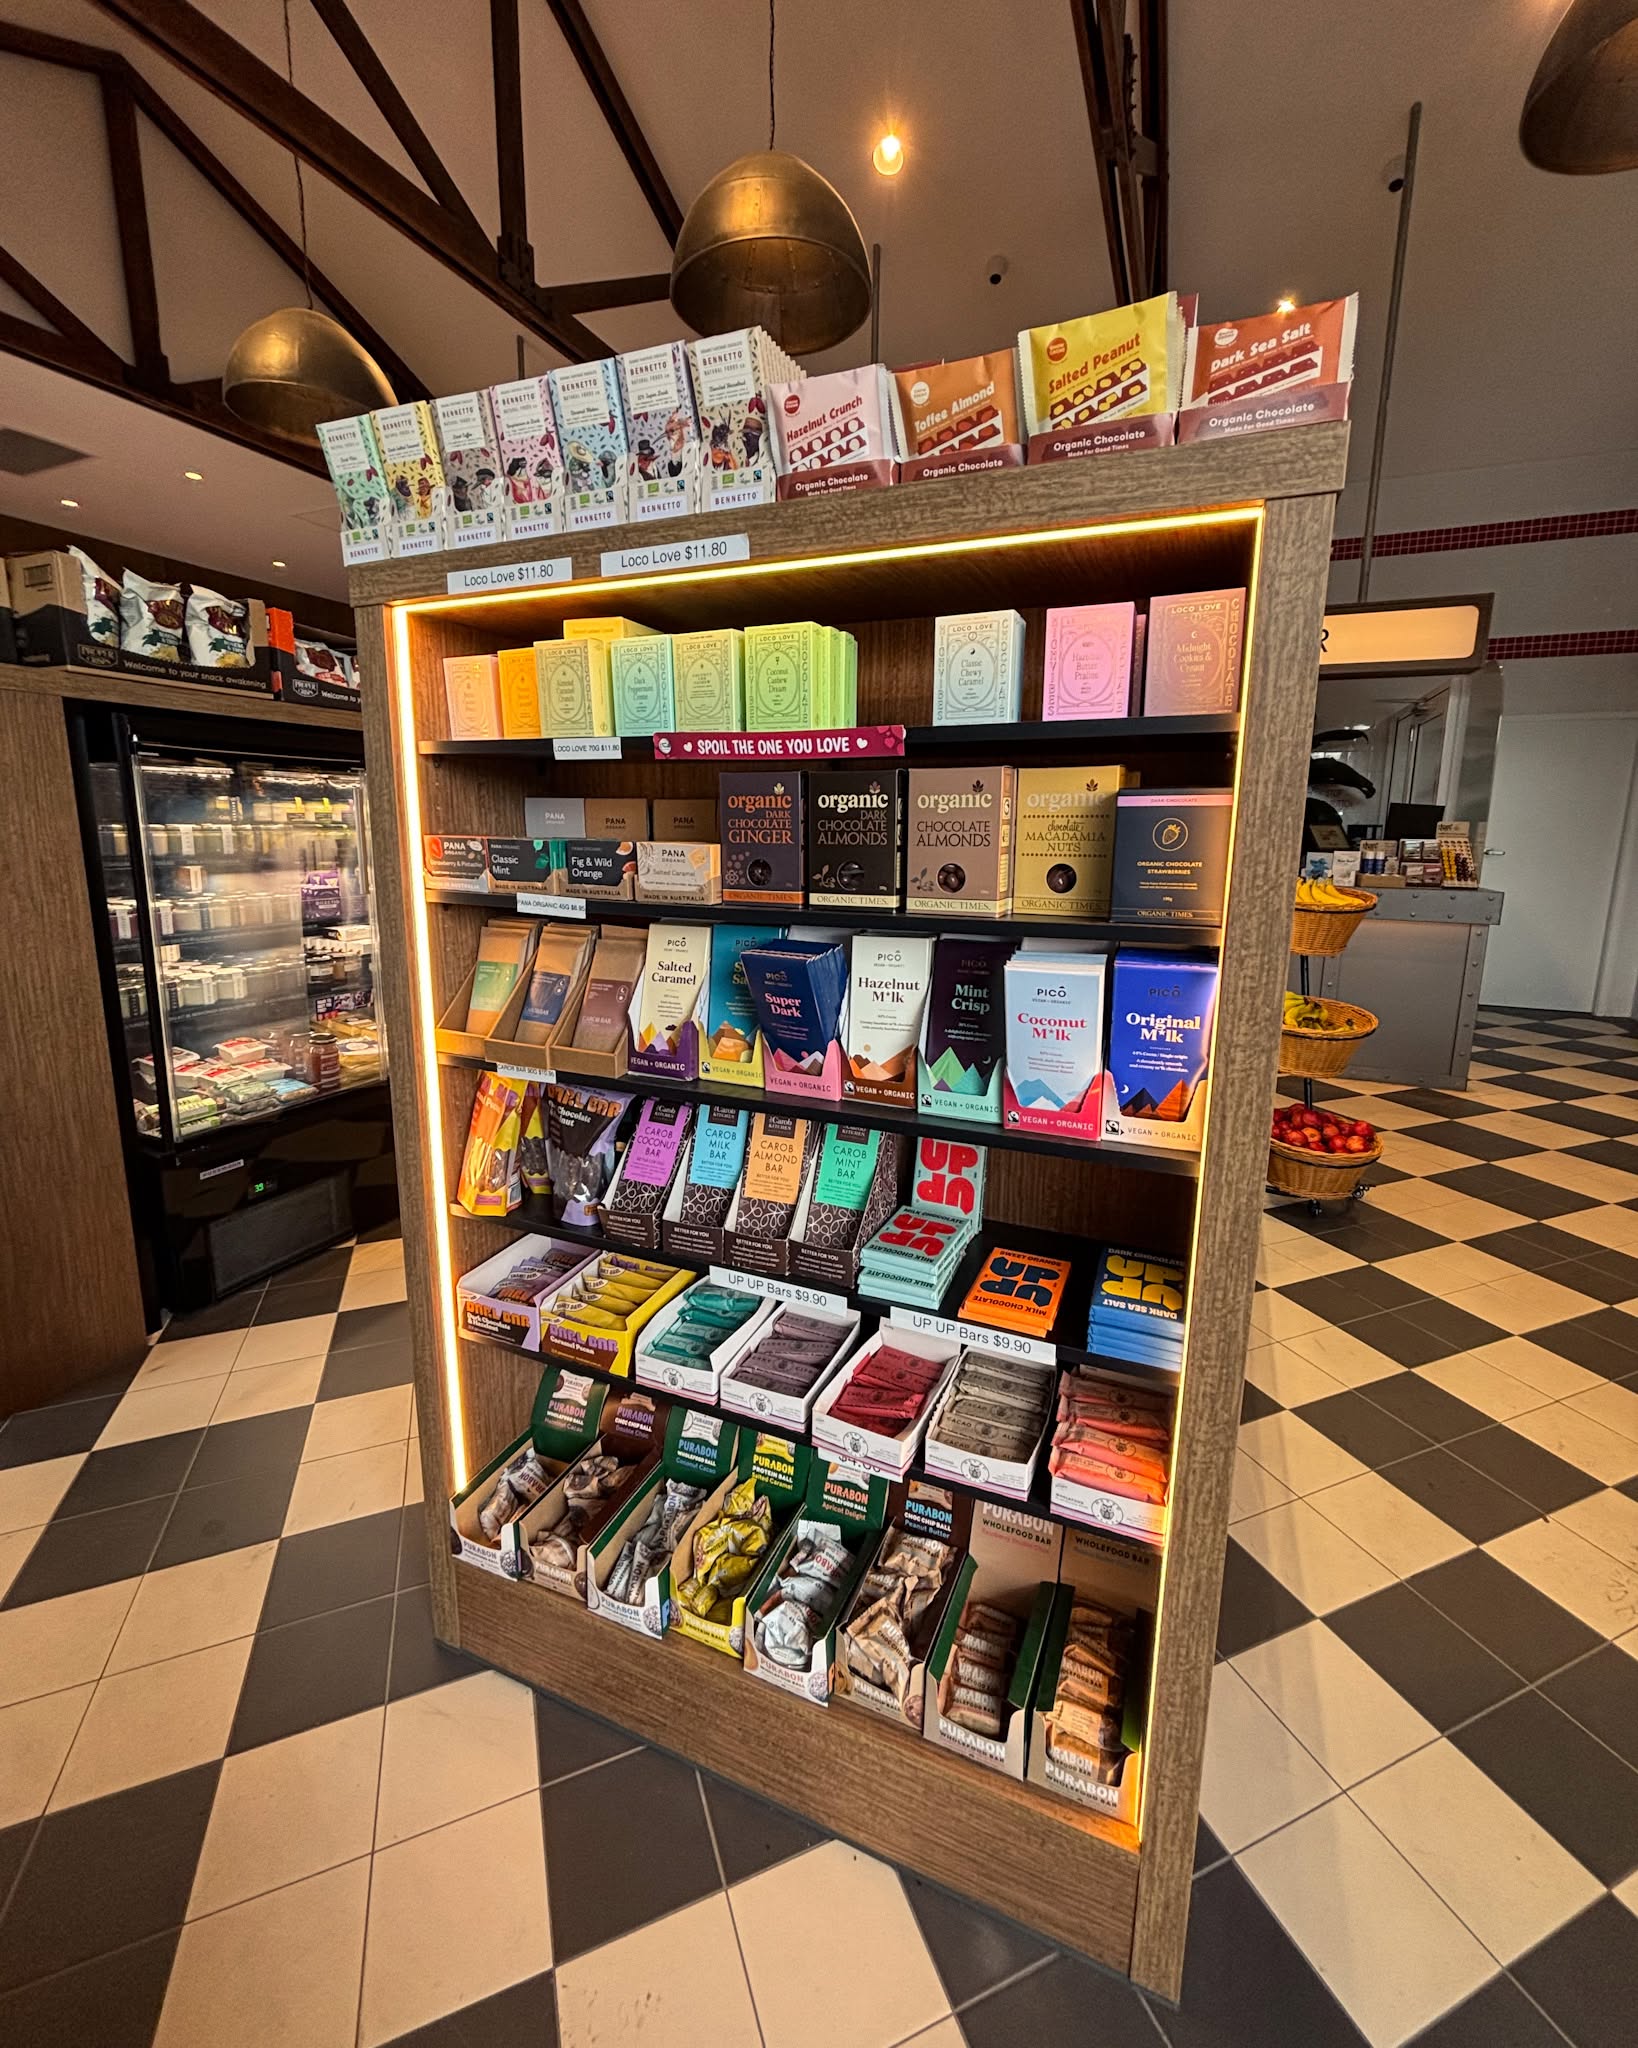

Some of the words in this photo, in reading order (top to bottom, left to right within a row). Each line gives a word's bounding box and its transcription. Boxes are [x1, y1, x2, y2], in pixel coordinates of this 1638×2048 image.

[1210, 349, 1245, 373] Dark
[1250, 338, 1277, 356] Sea
[1281, 323, 1311, 344] Salt
[1049, 365, 1089, 393] Salted
[1093, 334, 1141, 368] Peanut
[914, 409, 948, 433] Toffee
[951, 381, 995, 415] Almond
[1209, 412, 1253, 427] Organic
[1255, 401, 1315, 420] Chocolate
[787, 414, 826, 442] Hazelnut
[830, 395, 863, 419] Crunch
[1053, 438, 1091, 453] Organic
[1094, 428, 1145, 445] Chocolate
[1067, 449, 1083, 458] Made
[1095, 446, 1110, 455] Good
[923, 465, 956, 478] Organic
[958, 458, 1003, 472] Chocolate
[796, 480, 826, 491] Organic
[828, 474, 868, 486] Chocolate
[715, 492, 757, 505] BENNETTO
[641, 501, 681, 514] BENNETTO
[575, 512, 612, 524] BENNETTO
[515, 522, 549, 534] BENNETTO
[621, 555, 649, 568] Loco
[652, 550, 681, 565] Love
[684, 541, 727, 562] $11.80
[464, 574, 488, 587] Loco
[491, 571, 515, 584] Love
[517, 564, 554, 581] $11.80
[1172, 606, 1195, 614] LOCO
[1199, 603, 1221, 611] LOVE
[124, 659, 166, 674] Welcome
[179, 669, 199, 679] your
[201, 673, 224, 682] snack
[225, 677, 266, 689] awakening
[960, 669, 982, 678] Chewy
[958, 677, 984, 687] Caramel
[697, 740, 730, 754] SPOIL
[732, 740, 754, 754] THE
[758, 740, 782, 754] ONE
[785, 738, 812, 753] YOU
[817, 737, 850, 752] LOVE
[728, 793, 792, 813] organic
[818, 792, 888, 814] organic
[918, 791, 992, 814] organic
[1027, 792, 1106, 812] organic
[673, 816, 695, 824] PANA
[861, 811, 887, 820] DARK
[728, 819, 792, 829] CHOCOLATE
[818, 820, 887, 831] CHOCOLATE
[917, 821, 990, 833] CHOCOLATE
[1048, 820, 1084, 832] chocolate
[728, 830, 793, 844] GINGER
[818, 831, 888, 845] ALMONDS
[917, 833, 991, 847] ALMONDS
[1025, 832, 1106, 842] MACADAMIA
[444, 842, 466, 850] PANA
[1047, 842, 1081, 852] NUTS
[491, 854, 519, 864] Classic
[661, 850, 685, 858] PANA
[571, 856, 584, 868] Fig
[586, 857, 593, 867] &
[594, 857, 613, 868] Wild
[492, 865, 510, 875] Mint
[572, 868, 603, 880] Orange
[817, 895, 857, 905] ORGANIC
[915, 899, 958, 910] ORGANIC
[1137, 910, 1169, 918] ORGANIC
[658, 961, 692, 973] Salted
[651, 973, 696, 985] Caramel
[858, 977, 920, 991] Hazelnut
[955, 984, 989, 998] Mint
[765, 993, 802, 1008] Super
[951, 997, 991, 1015] Crisp
[770, 1004, 802, 1018] Dark
[1017, 1012, 1088, 1029] Coconut
[1126, 1012, 1201, 1031] Original
[855, 1085, 877, 1094] VEGAN
[884, 1089, 915, 1099] ORGANIC
[935, 1098, 957, 1108] VEGAN
[965, 1102, 999, 1113] ORGANIC
[1022, 1116, 1048, 1125] VEGAN
[1056, 1120, 1094, 1131] ORGANIC
[645, 1127, 673, 1138] CAROB
[705, 1128, 737, 1140] CAROB
[842, 1129, 865, 1137] KITCHEN
[1128, 1127, 1153, 1136] VEGAN
[1161, 1131, 1197, 1142] ORGANIC
[637, 1136, 676, 1149] COCONUT
[709, 1139, 730, 1149] MILK
[760, 1140, 794, 1152] CAROB
[645, 1147, 661, 1157] BAR
[709, 1150, 727, 1160] BAR
[754, 1151, 798, 1164] ALMOND
[833, 1146, 867, 1159] CAROB
[920, 1138, 978, 1176] UP
[765, 1163, 783, 1174] BAR
[835, 1157, 862, 1169] MINT
[837, 1168, 855, 1179] BAR
[904, 1208, 921, 1216] MILK
[922, 1211, 964, 1224] CHOCOLATE
[1000, 1250, 1027, 1260] SWEET
[1028, 1255, 1062, 1267] ORANGE
[1108, 1248, 1132, 1256] DARK
[990, 1256, 1060, 1283] UP
[728, 1273, 744, 1284] UP
[747, 1278, 765, 1290] UP
[767, 1283, 792, 1298] Bars
[795, 1290, 827, 1307] $9.90
[973, 1295, 1024, 1311] CHOCOLATE
[1103, 1298, 1126, 1309] SALT
[1127, 1303, 1147, 1313] SEA
[1025, 1306, 1047, 1316] MILK
[1152, 1309, 1178, 1320] DARK
[913, 1315, 932, 1328] UP
[936, 1321, 955, 1334] UP
[959, 1326, 989, 1344] Bars
[993, 1335, 1032, 1354] $9.90
[548, 1400, 586, 1418] PURABON
[617, 1407, 654, 1425] PURABON
[679, 1439, 717, 1459] PURABON
[677, 1451, 704, 1463] WHOLEFOOD
[704, 1458, 716, 1467] BALL
[753, 1454, 794, 1475] PURABON
[752, 1465, 778, 1479] PROTEIN
[778, 1473, 793, 1483] BALL
[824, 1482, 868, 1504] PURABON
[823, 1494, 854, 1508] WHOLEFOOD
[854, 1503, 867, 1513] BALL
[822, 1502, 844, 1515] Apricot
[844, 1509, 866, 1521] Delight
[905, 1500, 952, 1524] PURABON
[904, 1512, 921, 1522] CHOC
[922, 1517, 936, 1526] CHIP
[936, 1521, 952, 1532] BALL
[904, 1520, 928, 1533] Peanut
[928, 1527, 950, 1539] Butter
[983, 1518, 1033, 1540] WHOLEFOOD
[1035, 1535, 1051, 1545] BAR
